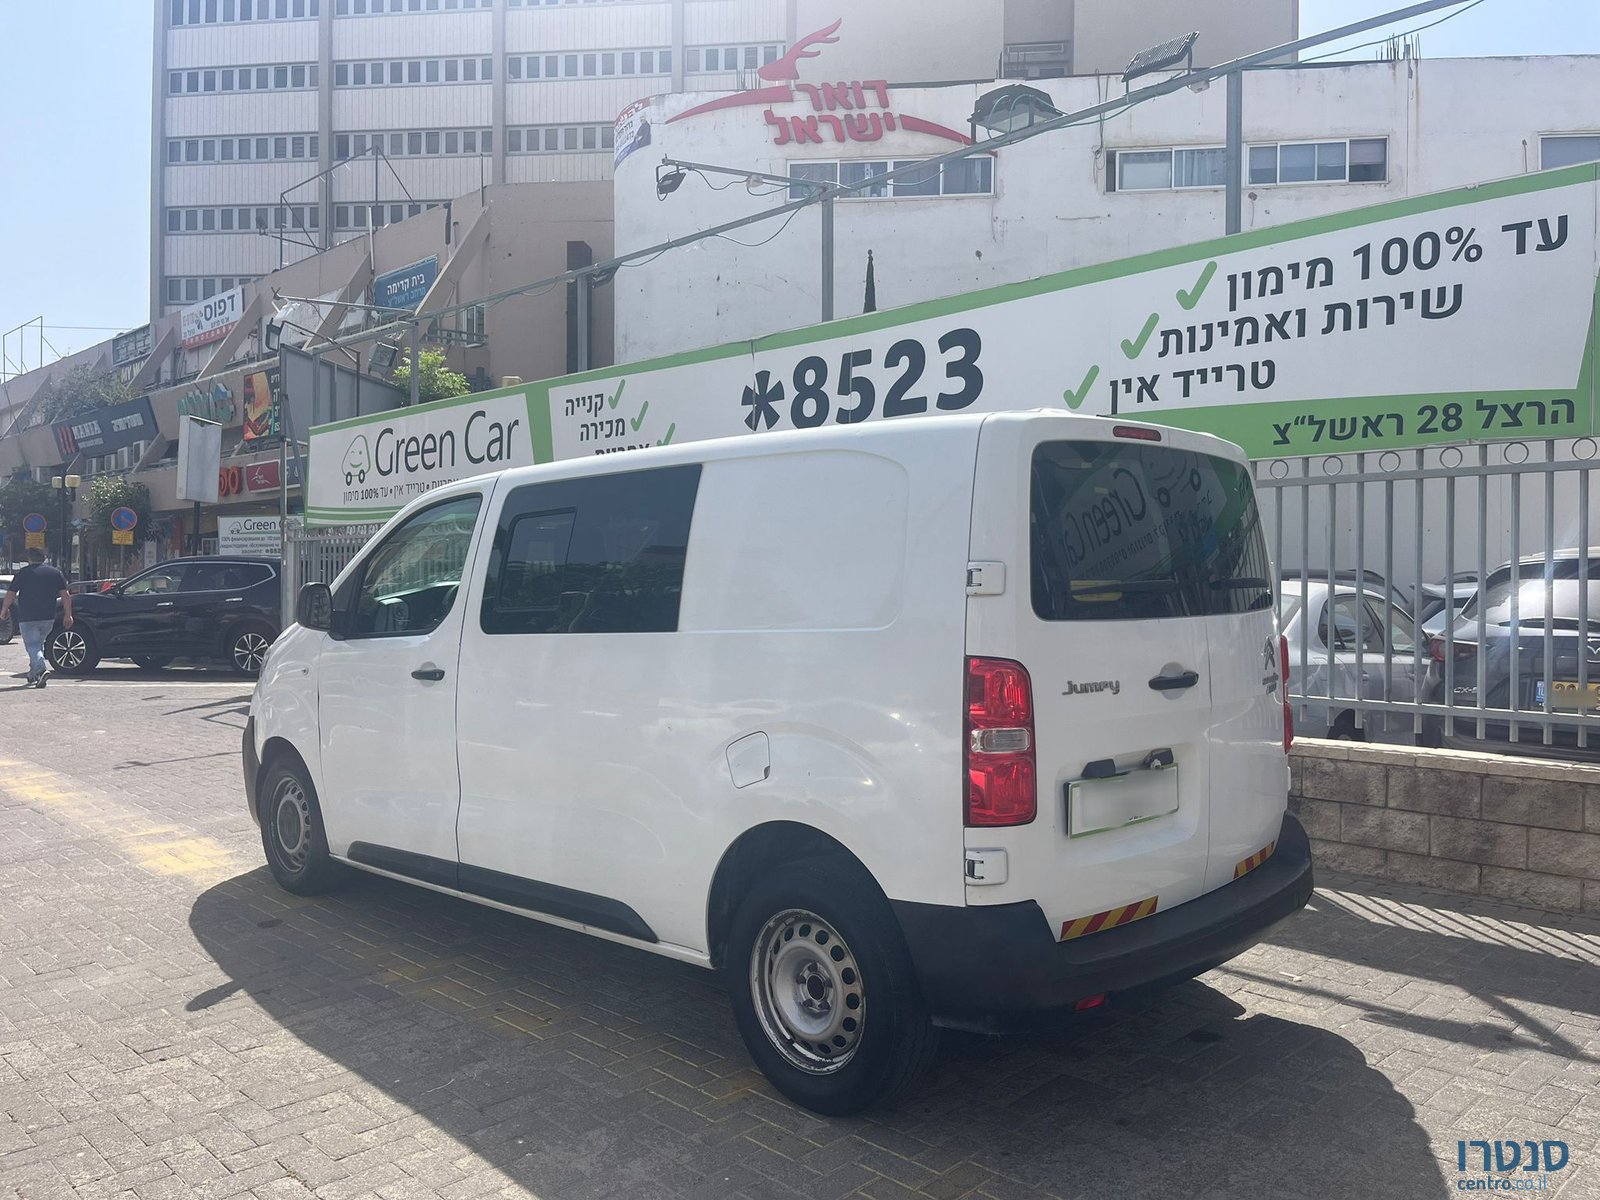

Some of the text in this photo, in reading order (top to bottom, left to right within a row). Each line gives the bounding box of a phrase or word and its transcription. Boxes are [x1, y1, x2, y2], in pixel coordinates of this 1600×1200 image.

[795, 80, 889, 111] דואר
[764, 110, 896, 145] ישראל
[1227, 214, 1569, 312] עד 100% מימון
[387, 273, 425, 296] בית קדימה
[203, 293, 236, 322] דפוס
[1158, 283, 1463, 358] שירות ואמינות
[1109, 359, 1276, 415] טרייד אין
[565, 393, 604, 418] קנייה
[1416, 402, 1464, 434] 28
[1475, 399, 1575, 429] הרצל
[580, 418, 626, 442] מכירה
[375, 410, 520, 476] Green Car
[343, 490, 359, 504] מימון
[361, 489, 379, 500] 100%
[380, 487, 388, 498] עד
[393, 484, 404, 499] אין
[406, 482, 425, 495] טרייד
[244, 519, 276, 530] Green
[1062, 680, 1120, 695] Jumpy
